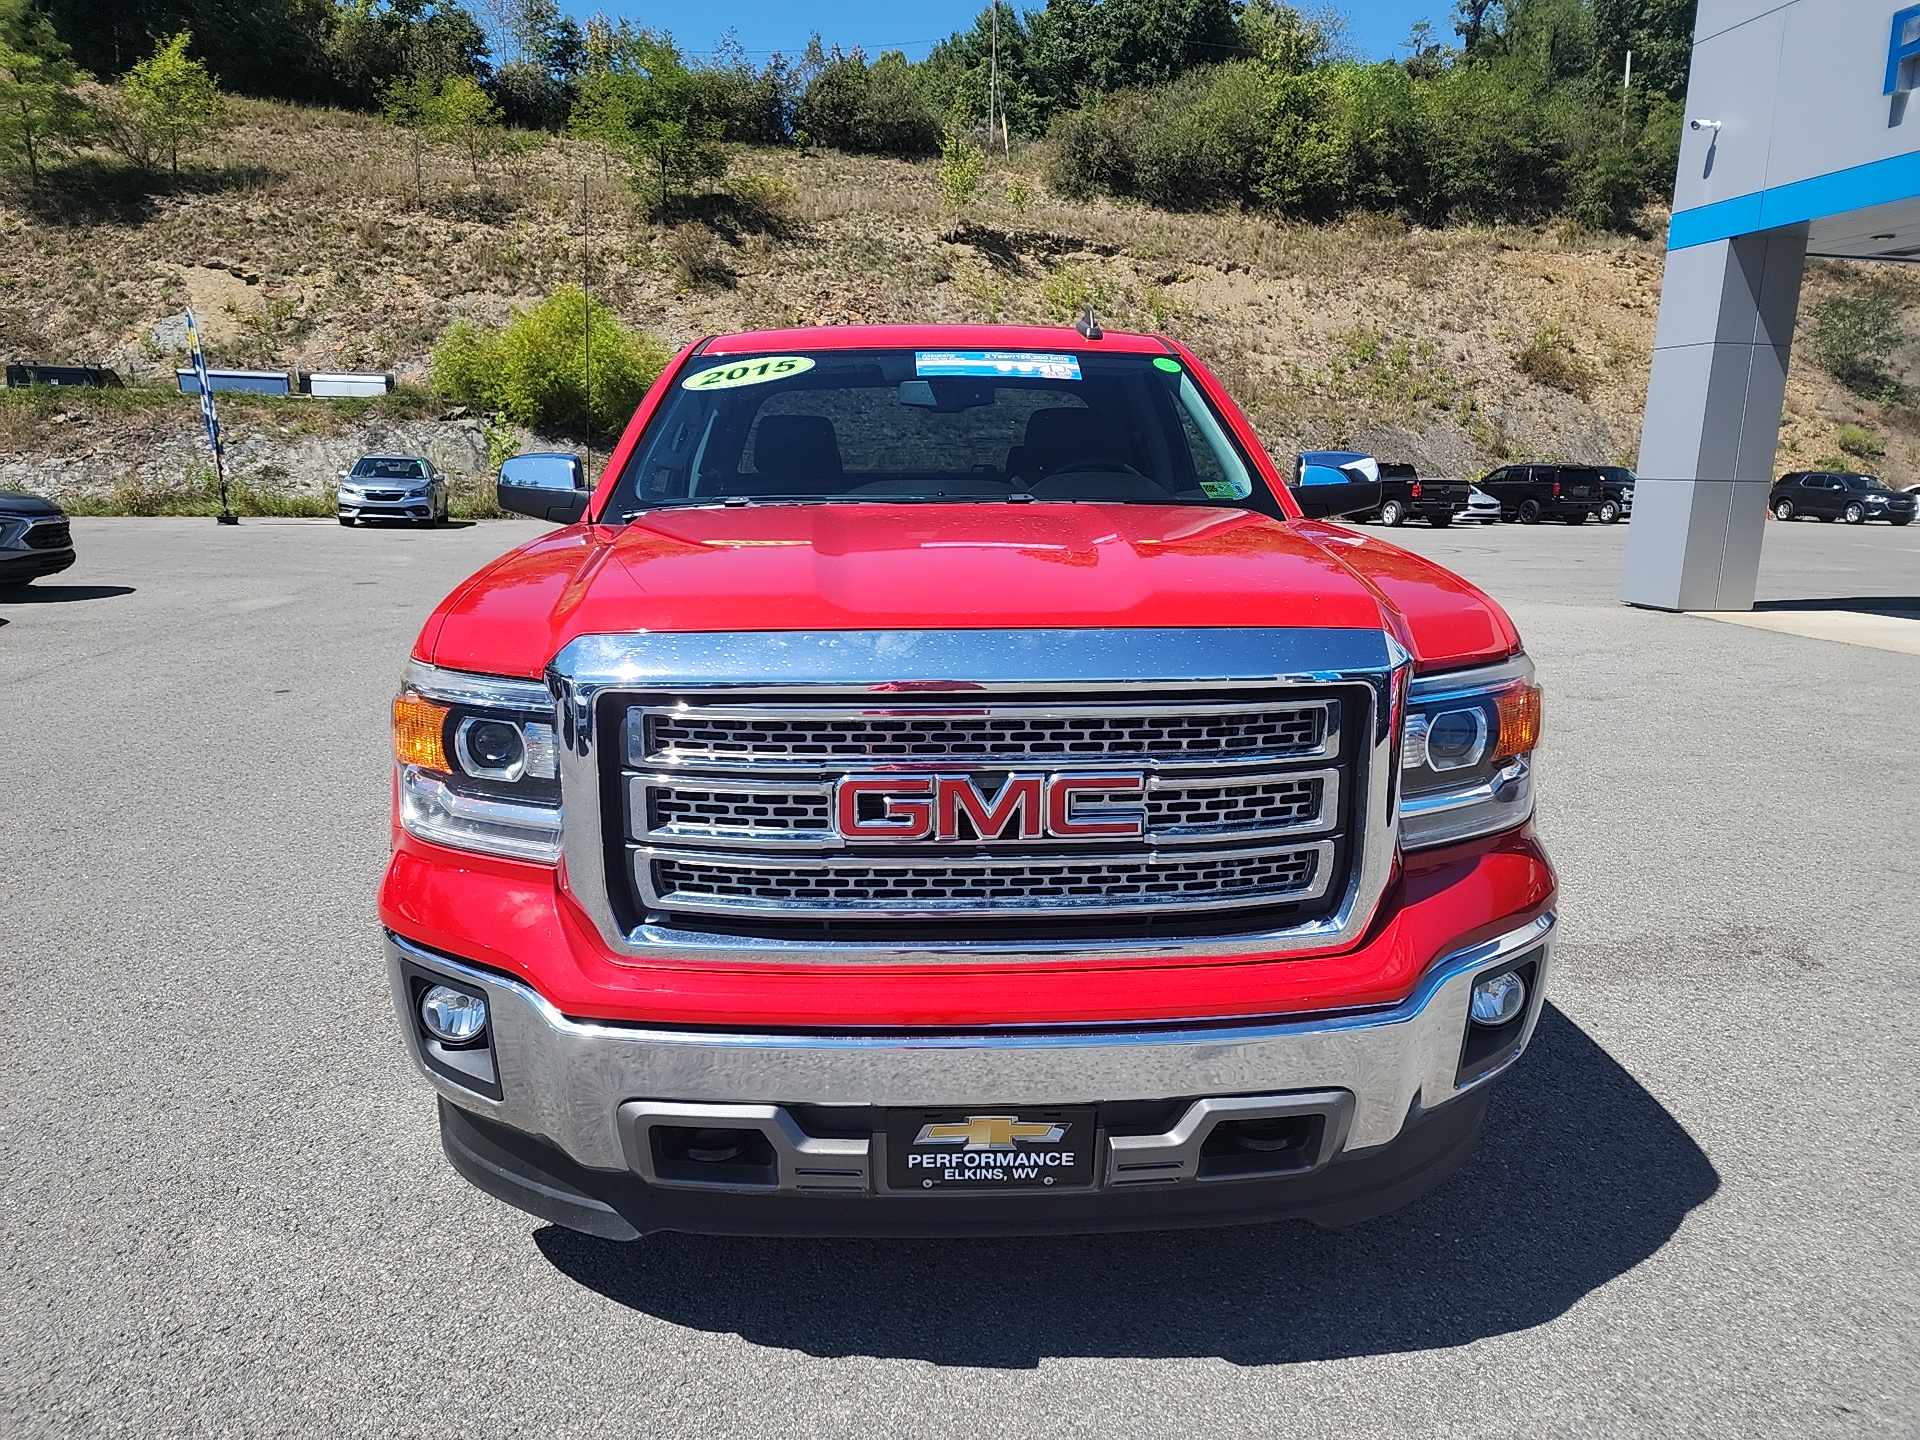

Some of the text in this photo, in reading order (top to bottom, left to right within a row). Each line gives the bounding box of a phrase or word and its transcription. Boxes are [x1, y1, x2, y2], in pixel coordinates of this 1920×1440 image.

[698, 359, 798, 387] 2015
[833, 772, 1146, 839] GMC
[908, 1153, 1074, 1168] PERFORMANCE
[944, 1167, 1039, 1182] ELKINS, WV
